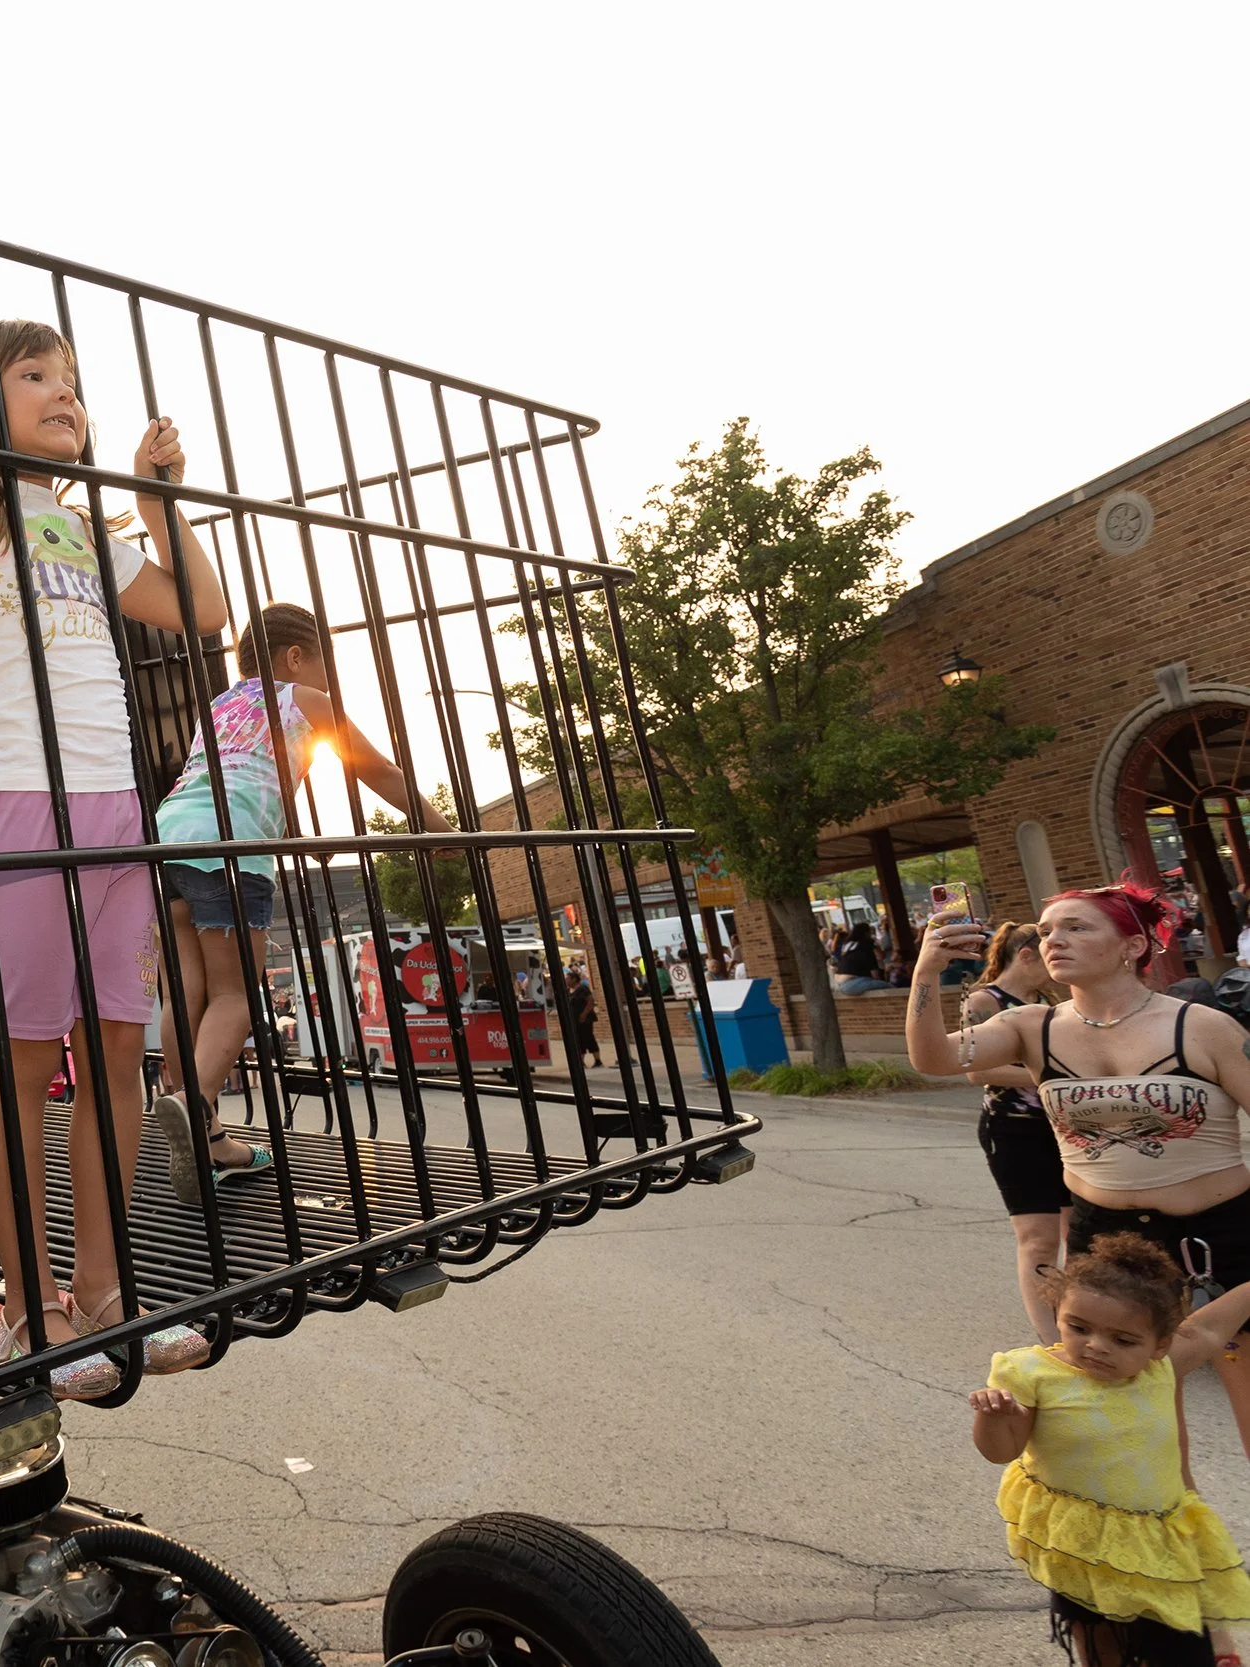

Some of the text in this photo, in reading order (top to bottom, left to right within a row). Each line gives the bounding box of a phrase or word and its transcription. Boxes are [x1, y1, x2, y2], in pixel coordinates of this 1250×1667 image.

[21, 599, 111, 650] Gala
[406, 959, 418, 968] Da
[420, 960, 438, 970] Udd
[1068, 1104, 1151, 1118] RIDE HARD
